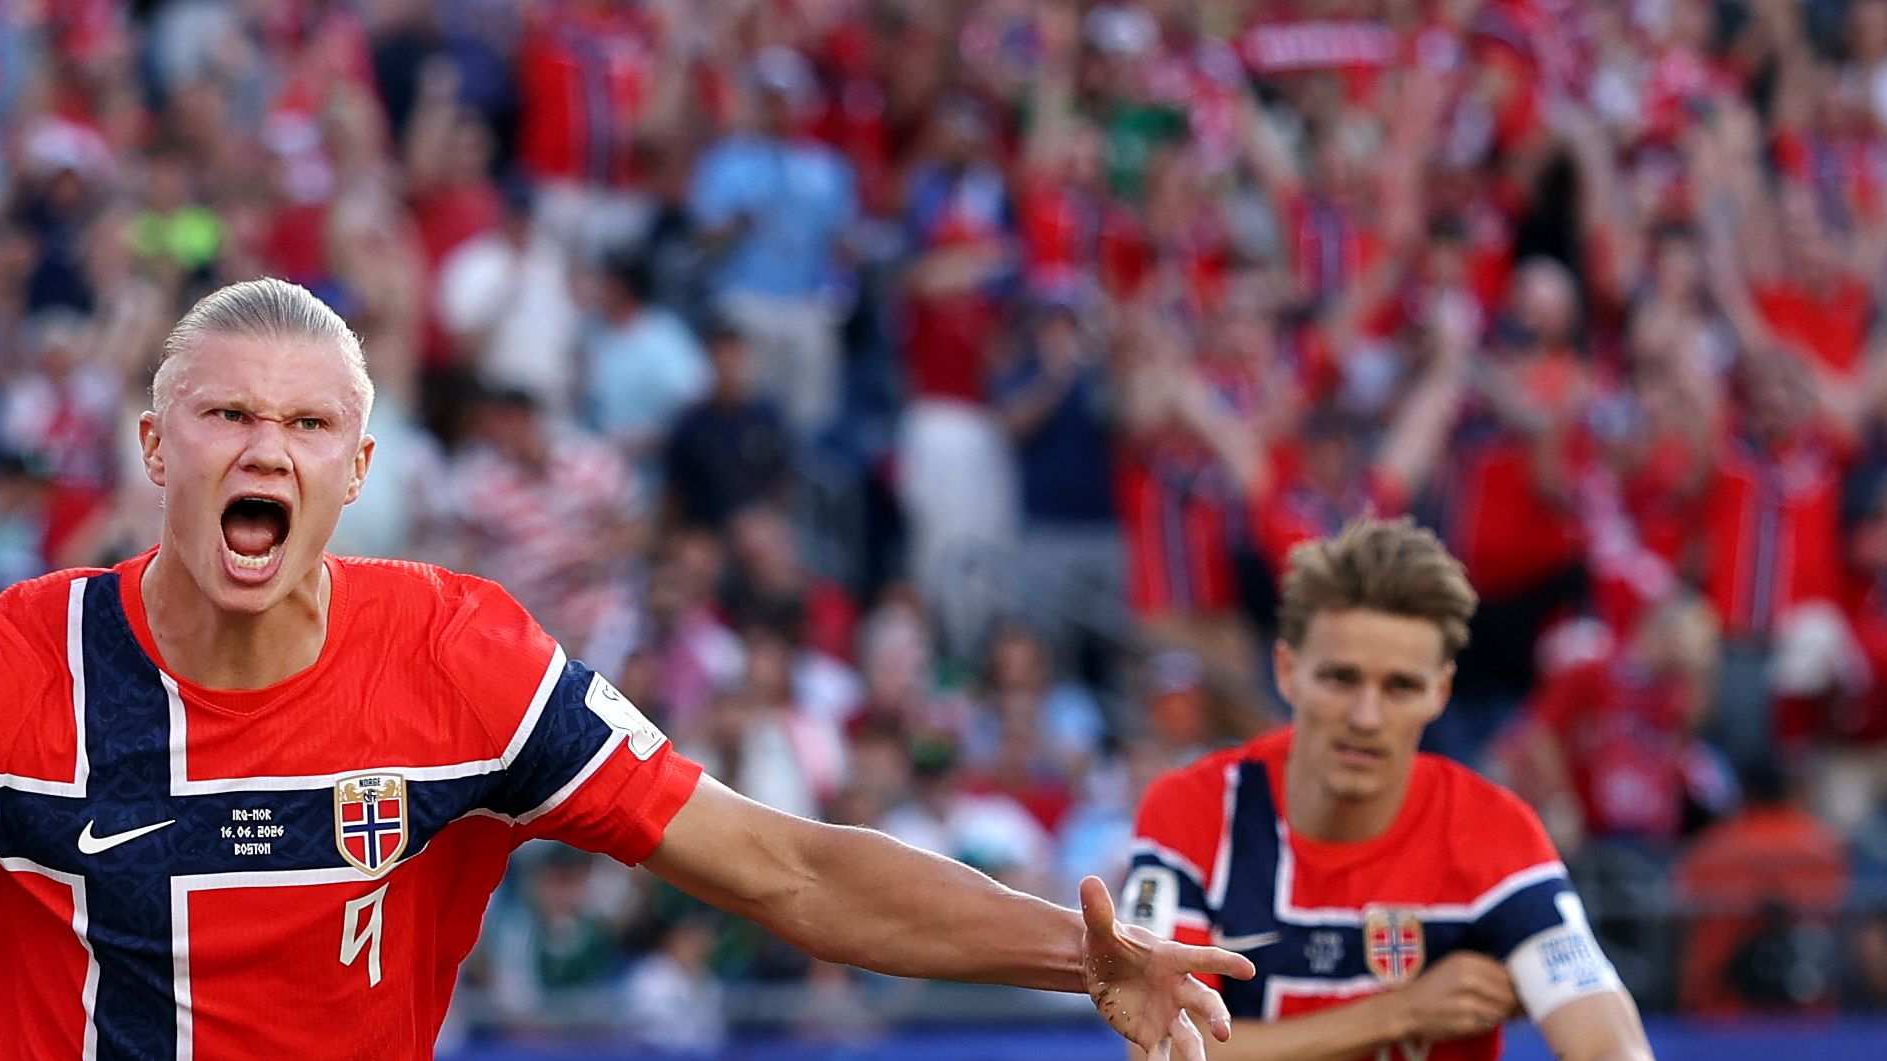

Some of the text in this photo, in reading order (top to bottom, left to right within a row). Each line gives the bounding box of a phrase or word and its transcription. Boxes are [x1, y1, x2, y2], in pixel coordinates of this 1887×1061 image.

[358, 778, 381, 788] NORGE
[232, 808, 272, 821] IRQ-NOR
[234, 842, 271, 856] BOSTON
[339, 881, 390, 988] 9
